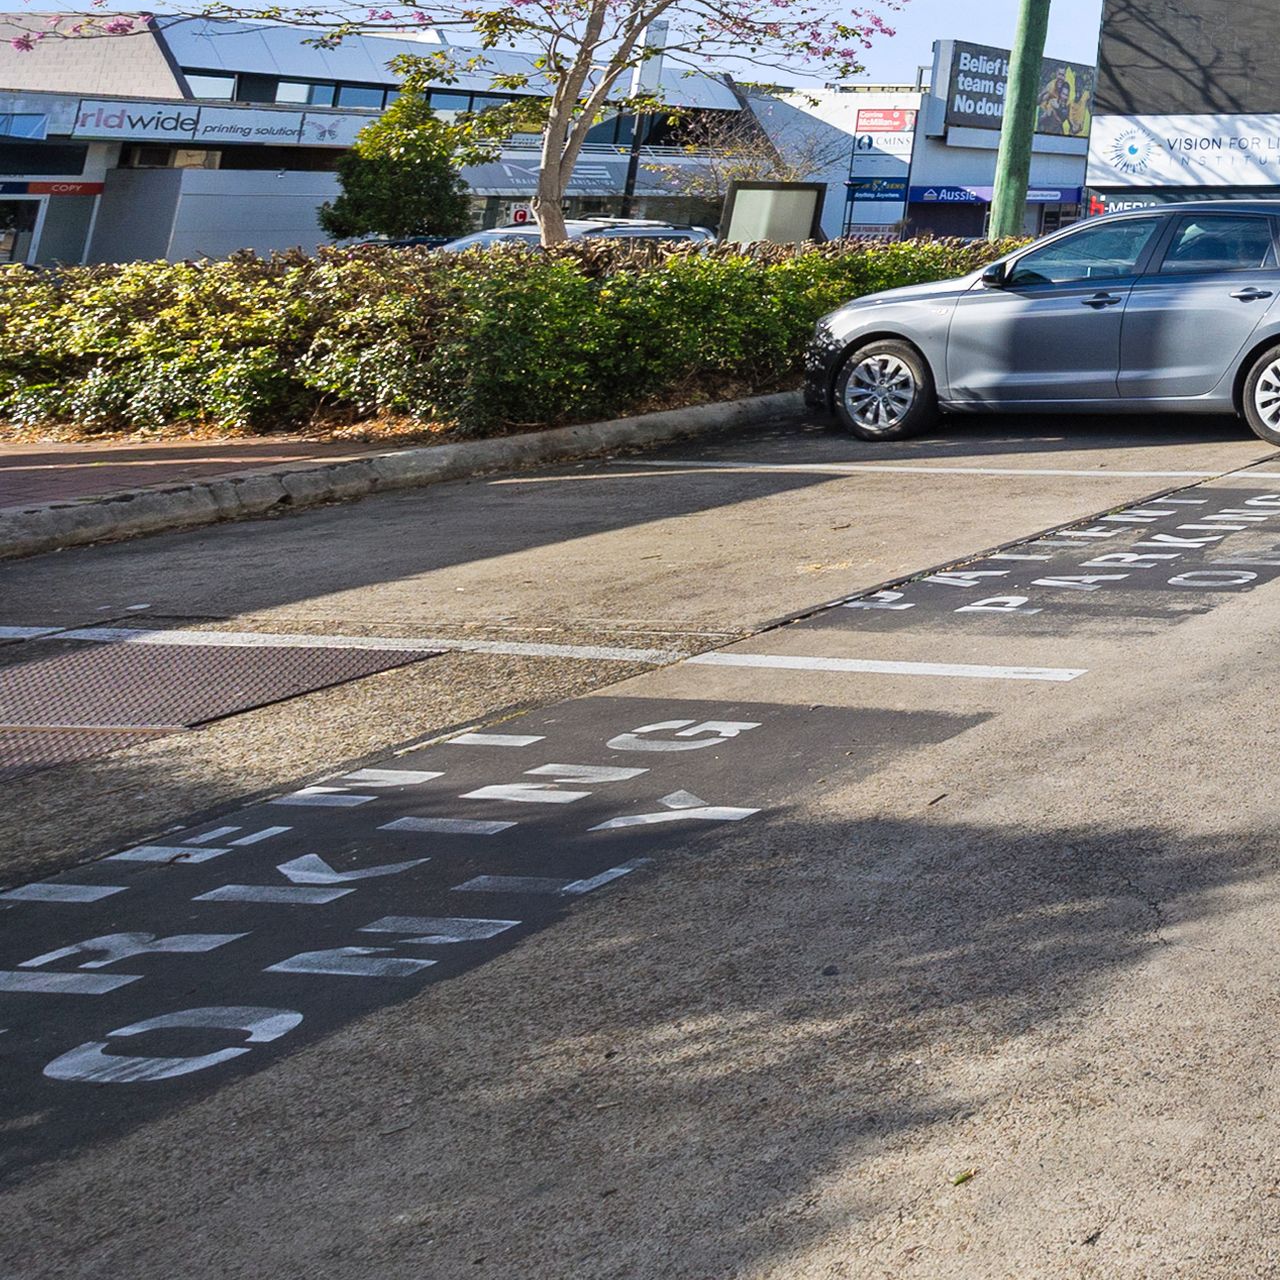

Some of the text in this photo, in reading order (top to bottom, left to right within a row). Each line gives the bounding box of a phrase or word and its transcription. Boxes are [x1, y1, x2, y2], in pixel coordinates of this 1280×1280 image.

[959, 52, 1000, 74] Belief
[957, 73, 994, 95] team
[954, 95, 974, 113] No
[77, 108, 199, 133] rldwide
[202, 123, 252, 136] printing
[1166, 137, 1222, 151] VISION
[1229, 137, 1260, 150] FOR
[51, 184, 82, 192] COPY
[938, 188, 977, 201] Aussie
[843, 496, 1209, 610] PATIENT
[43, 790, 762, 1083] ONLY
